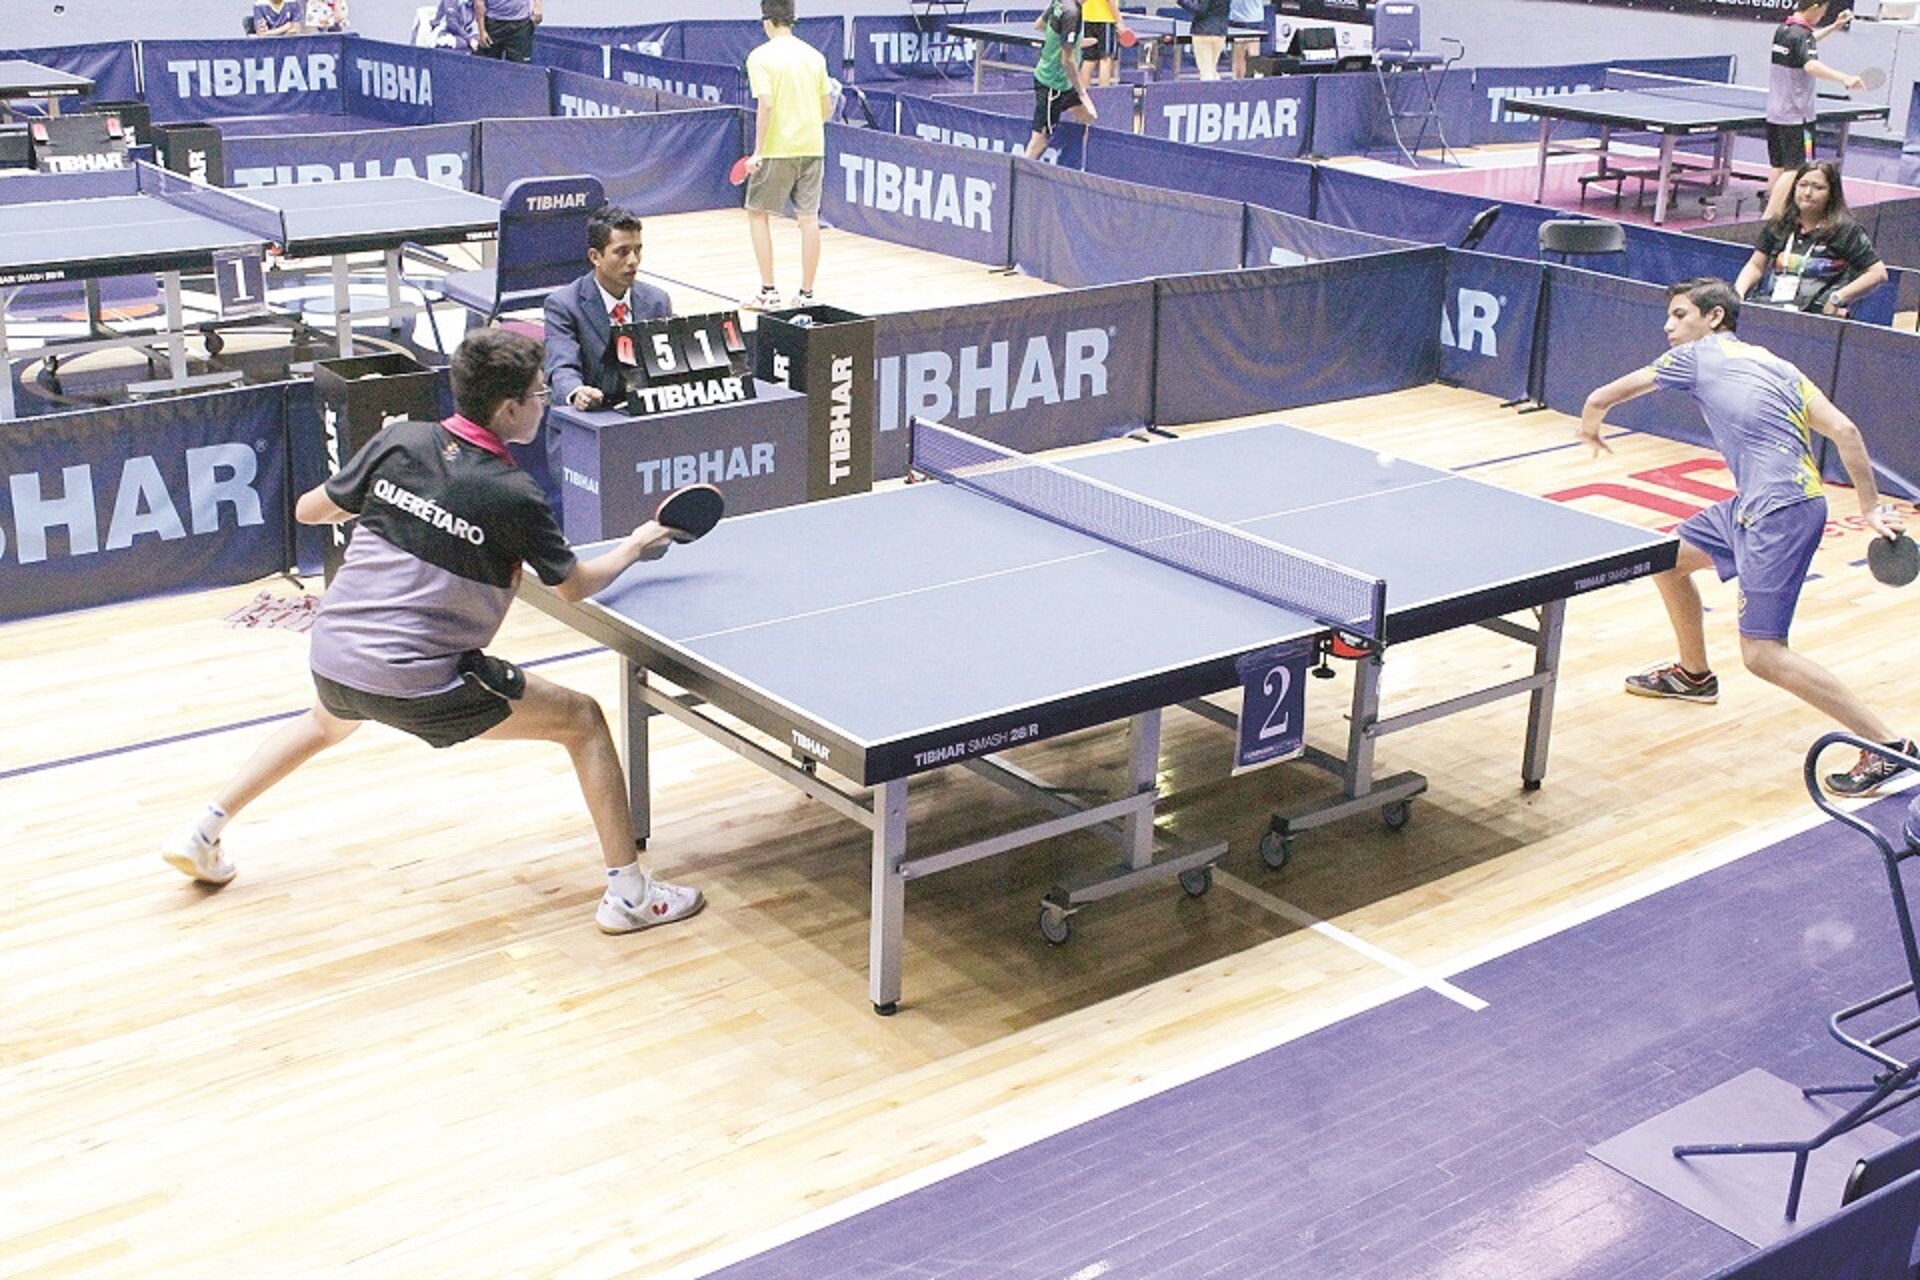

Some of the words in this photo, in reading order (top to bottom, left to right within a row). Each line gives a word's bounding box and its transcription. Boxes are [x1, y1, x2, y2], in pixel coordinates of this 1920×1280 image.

[167, 53, 338, 99] TIBHAR
[356, 58, 433, 107] TIBHA
[1163, 98, 1298, 144] TIBHAR
[43, 151, 123, 174] TIBHAR
[525, 193, 587, 211] TIBHAR
[839, 152, 992, 233] TIBHAR
[226, 258, 255, 302] 1
[651, 333, 677, 371] 5
[693, 329, 718, 365] 1
[721, 320, 741, 350] 1
[637, 377, 746, 413] TIBHAR
[873, 328, 1110, 433] IBHAR
[829, 355, 853, 485] TIBHAR
[636, 441, 776, 496] TIBHAR
[0, 443, 265, 565] HAR
[373, 479, 486, 545] QUERÉTARO
[1259, 665, 1291, 741] 2
[791, 730, 831, 761] TIBHAR
[913, 743, 966, 767] TIBHAR
[967, 732, 1009, 754] SMASH
[1028, 723, 1040, 737] R
